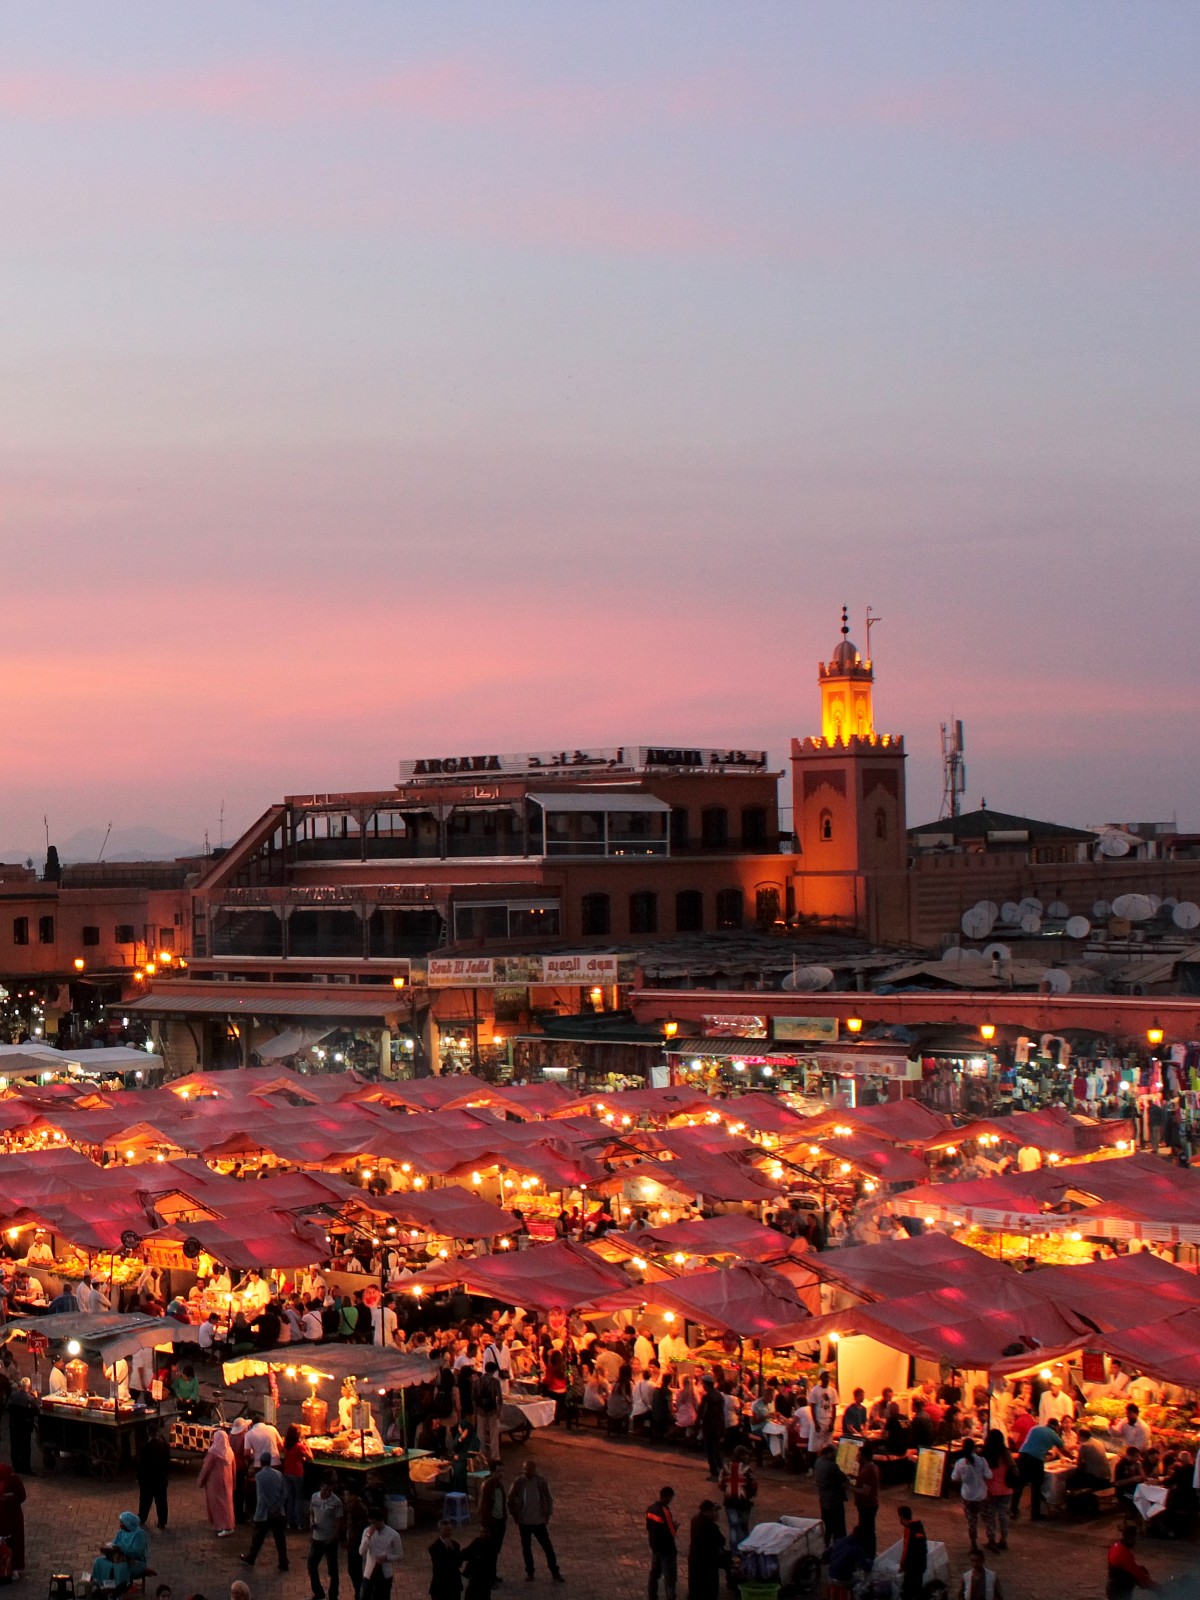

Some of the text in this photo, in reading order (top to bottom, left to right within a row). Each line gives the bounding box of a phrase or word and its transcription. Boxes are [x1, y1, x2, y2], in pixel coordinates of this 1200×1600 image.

[412, 755, 502, 775] ARGANA
[430, 961, 451, 974] Souk
[454, 960, 464, 974] El
